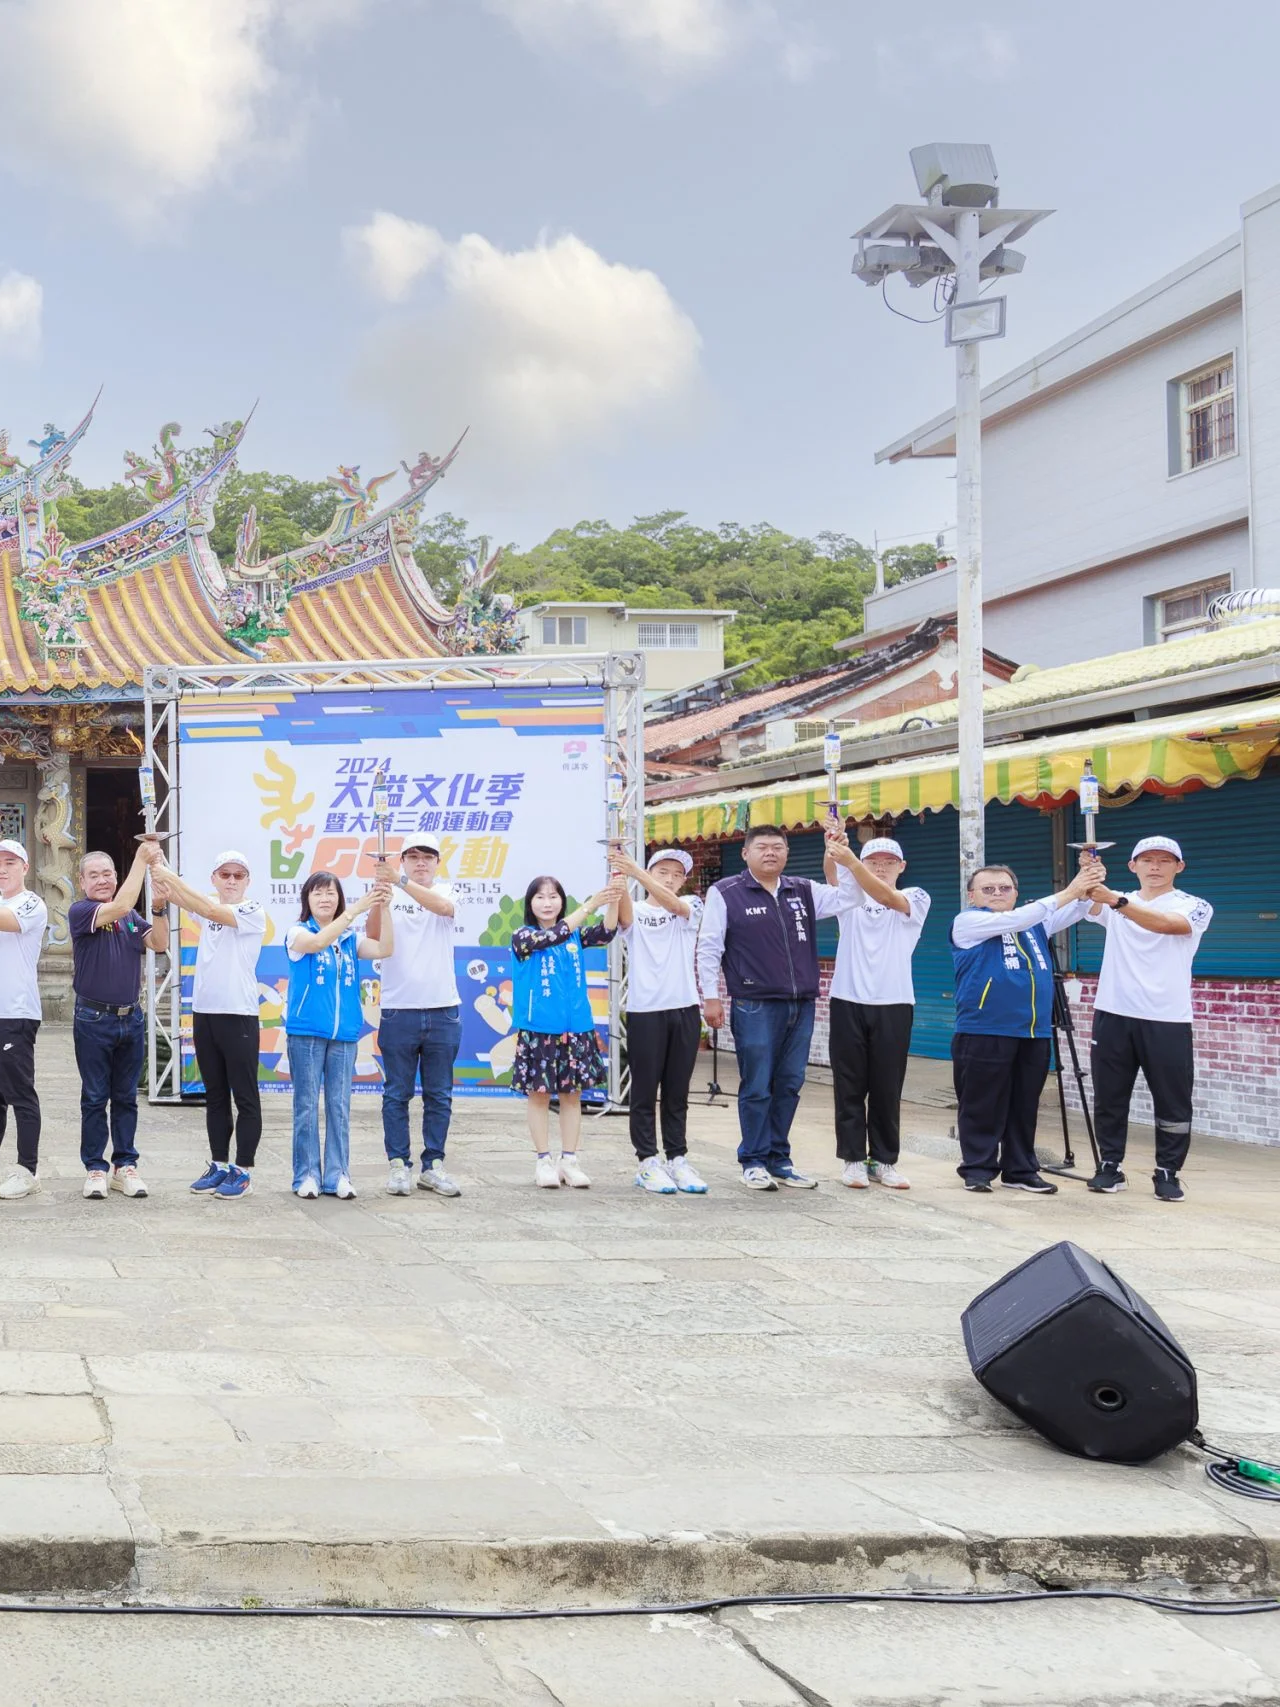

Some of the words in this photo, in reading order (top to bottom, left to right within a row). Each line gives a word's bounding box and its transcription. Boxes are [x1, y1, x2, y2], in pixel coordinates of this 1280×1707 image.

[335, 757, 392, 774] 2024
[329, 772, 525, 809] 大隘文化季
[745, 906, 768, 916] KMT
